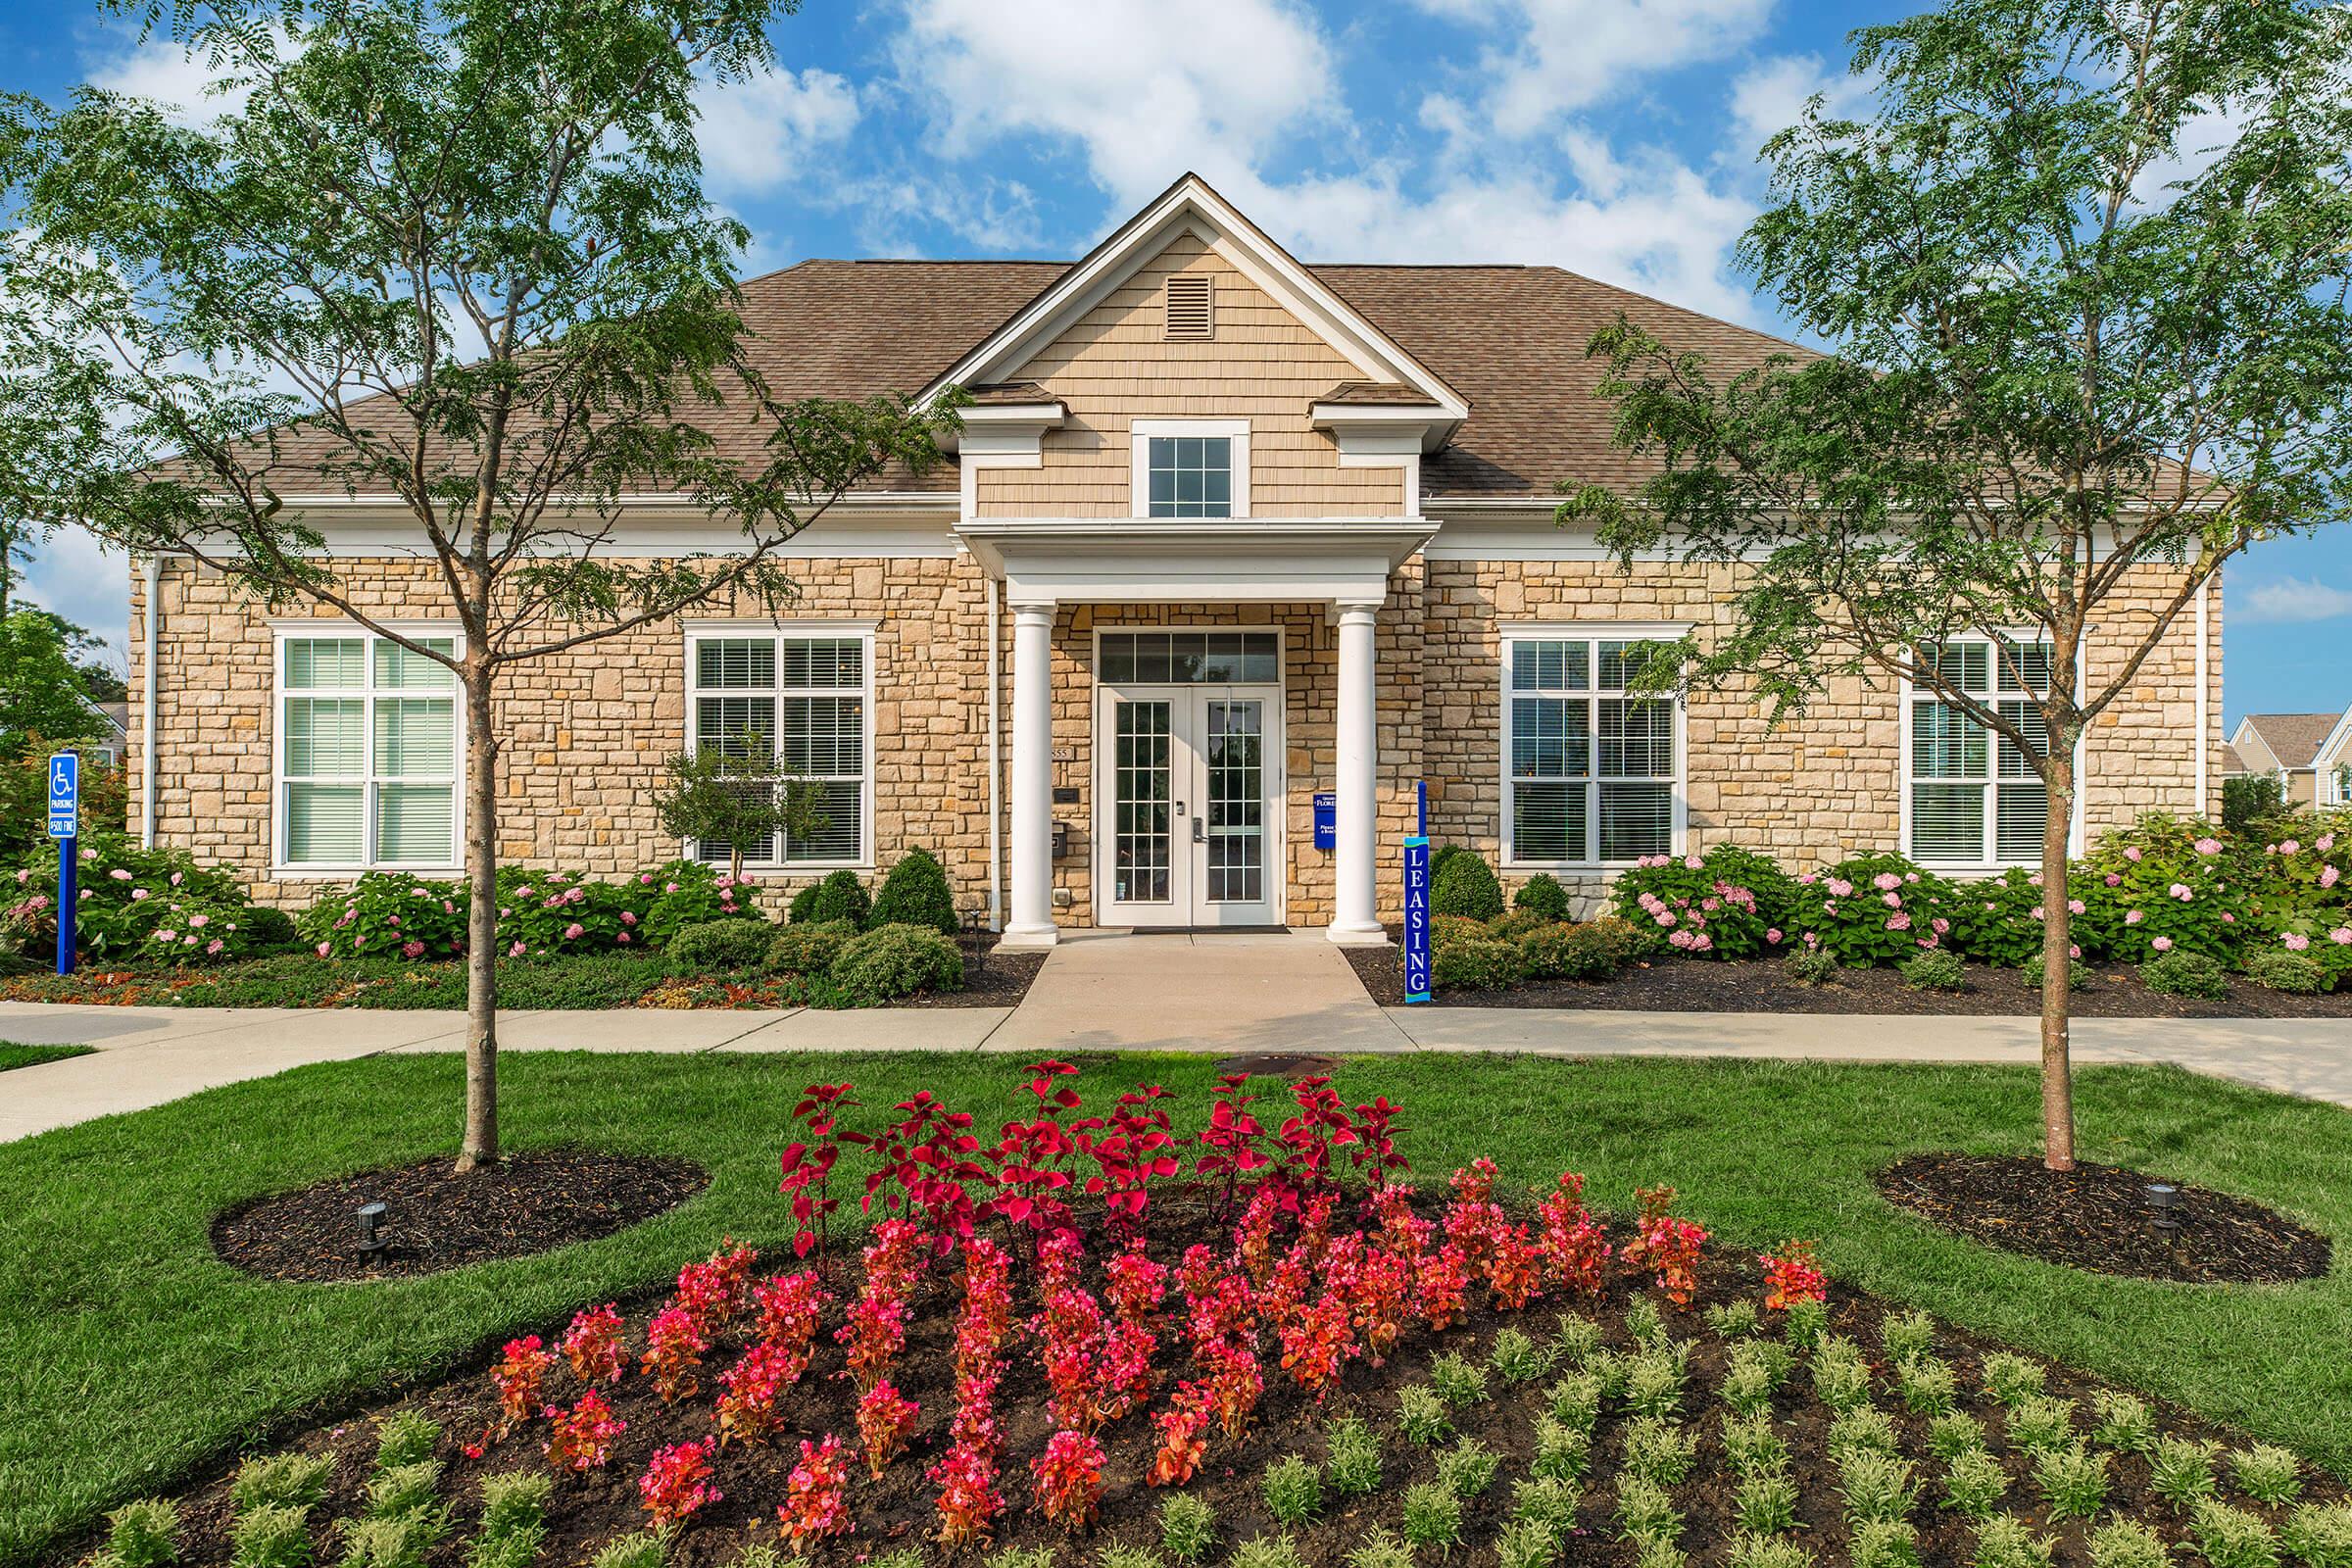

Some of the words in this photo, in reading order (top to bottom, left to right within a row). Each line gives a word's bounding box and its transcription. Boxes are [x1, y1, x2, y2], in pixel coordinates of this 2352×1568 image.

[51, 799, 74, 808] PARKING
[50, 820, 63, 832] $500
[63, 820, 74, 832] FINE
[1409, 849, 1425, 991] LEASING
